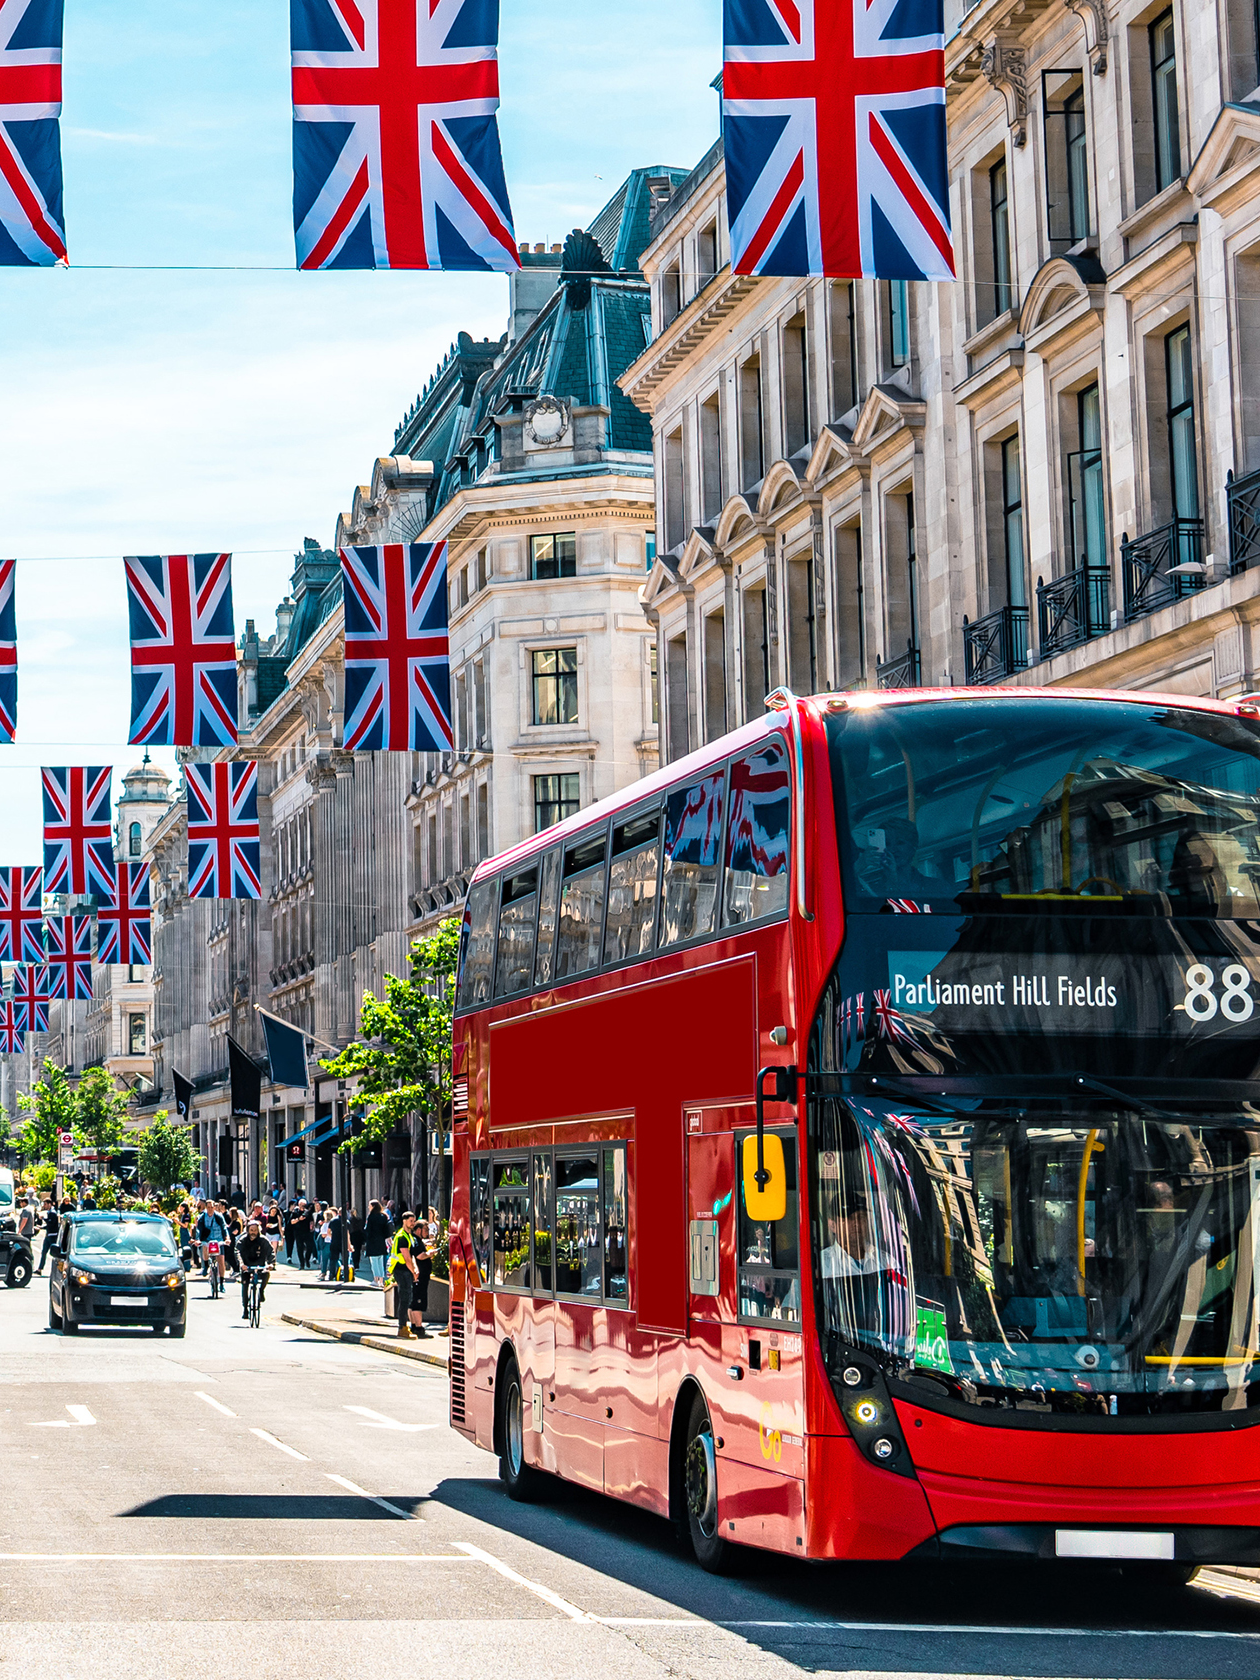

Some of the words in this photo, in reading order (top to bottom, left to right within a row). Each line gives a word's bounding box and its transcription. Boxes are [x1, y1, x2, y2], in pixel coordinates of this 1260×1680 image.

[894, 973, 1006, 1005] Parliament
[1012, 975, 1051, 1006] Hill
[1057, 975, 1118, 1007] Fields
[1183, 963, 1254, 1023] 88
[234, 1108, 259, 1117] lululemon
